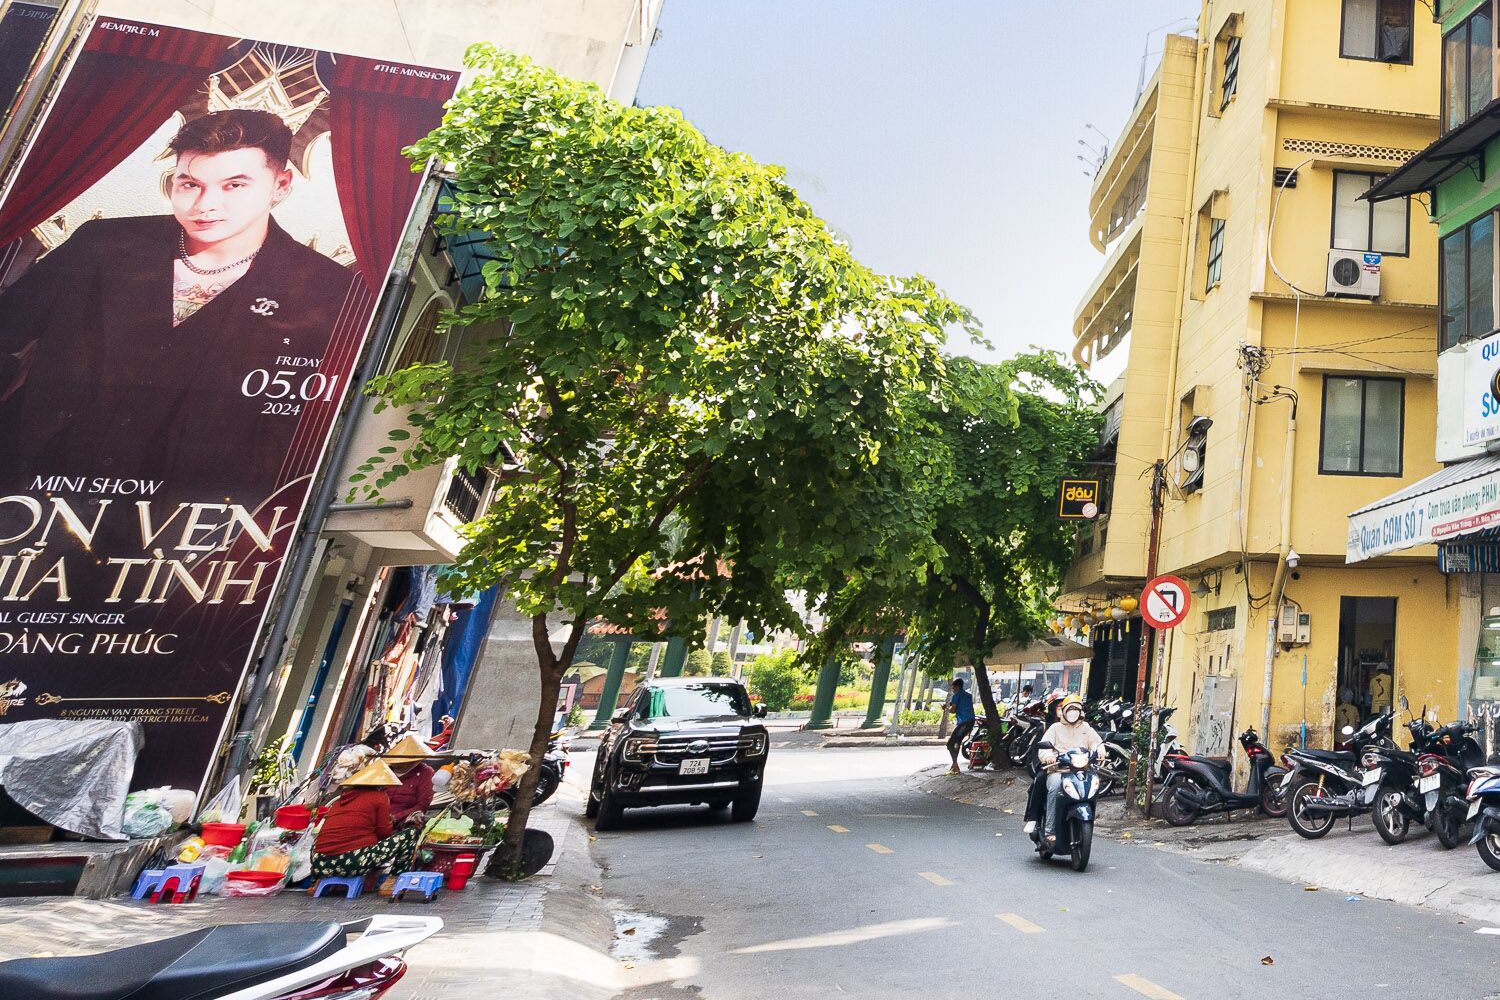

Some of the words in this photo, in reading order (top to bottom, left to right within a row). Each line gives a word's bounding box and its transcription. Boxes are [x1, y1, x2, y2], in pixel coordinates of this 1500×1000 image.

[373, 63, 400, 75] #THE
[400, 68, 453, 82] MINISHOW
[275, 355, 324, 368] FRIDAY
[241, 368, 339, 402] 05.01
[261, 401, 301, 416] 2024
[30, 475, 87, 494] MINI
[87, 478, 164, 496] SHOW
[1361, 523, 1380, 554] Quán
[1418, 508, 1424, 537] 7
[104, 548, 270, 605] TÌNH
[17, 611, 70, 624] GUEST
[70, 613, 126, 625] SINGER
[88, 629, 178, 655] PHÚC
[60, 708, 68, 717] 8
[69, 708, 110, 717] NGUYEN
[111, 707, 132, 716] VAN
[131, 707, 165, 716] TRANG
[166, 707, 197, 716] STREET
[128, 715, 169, 724] DISTRICT
